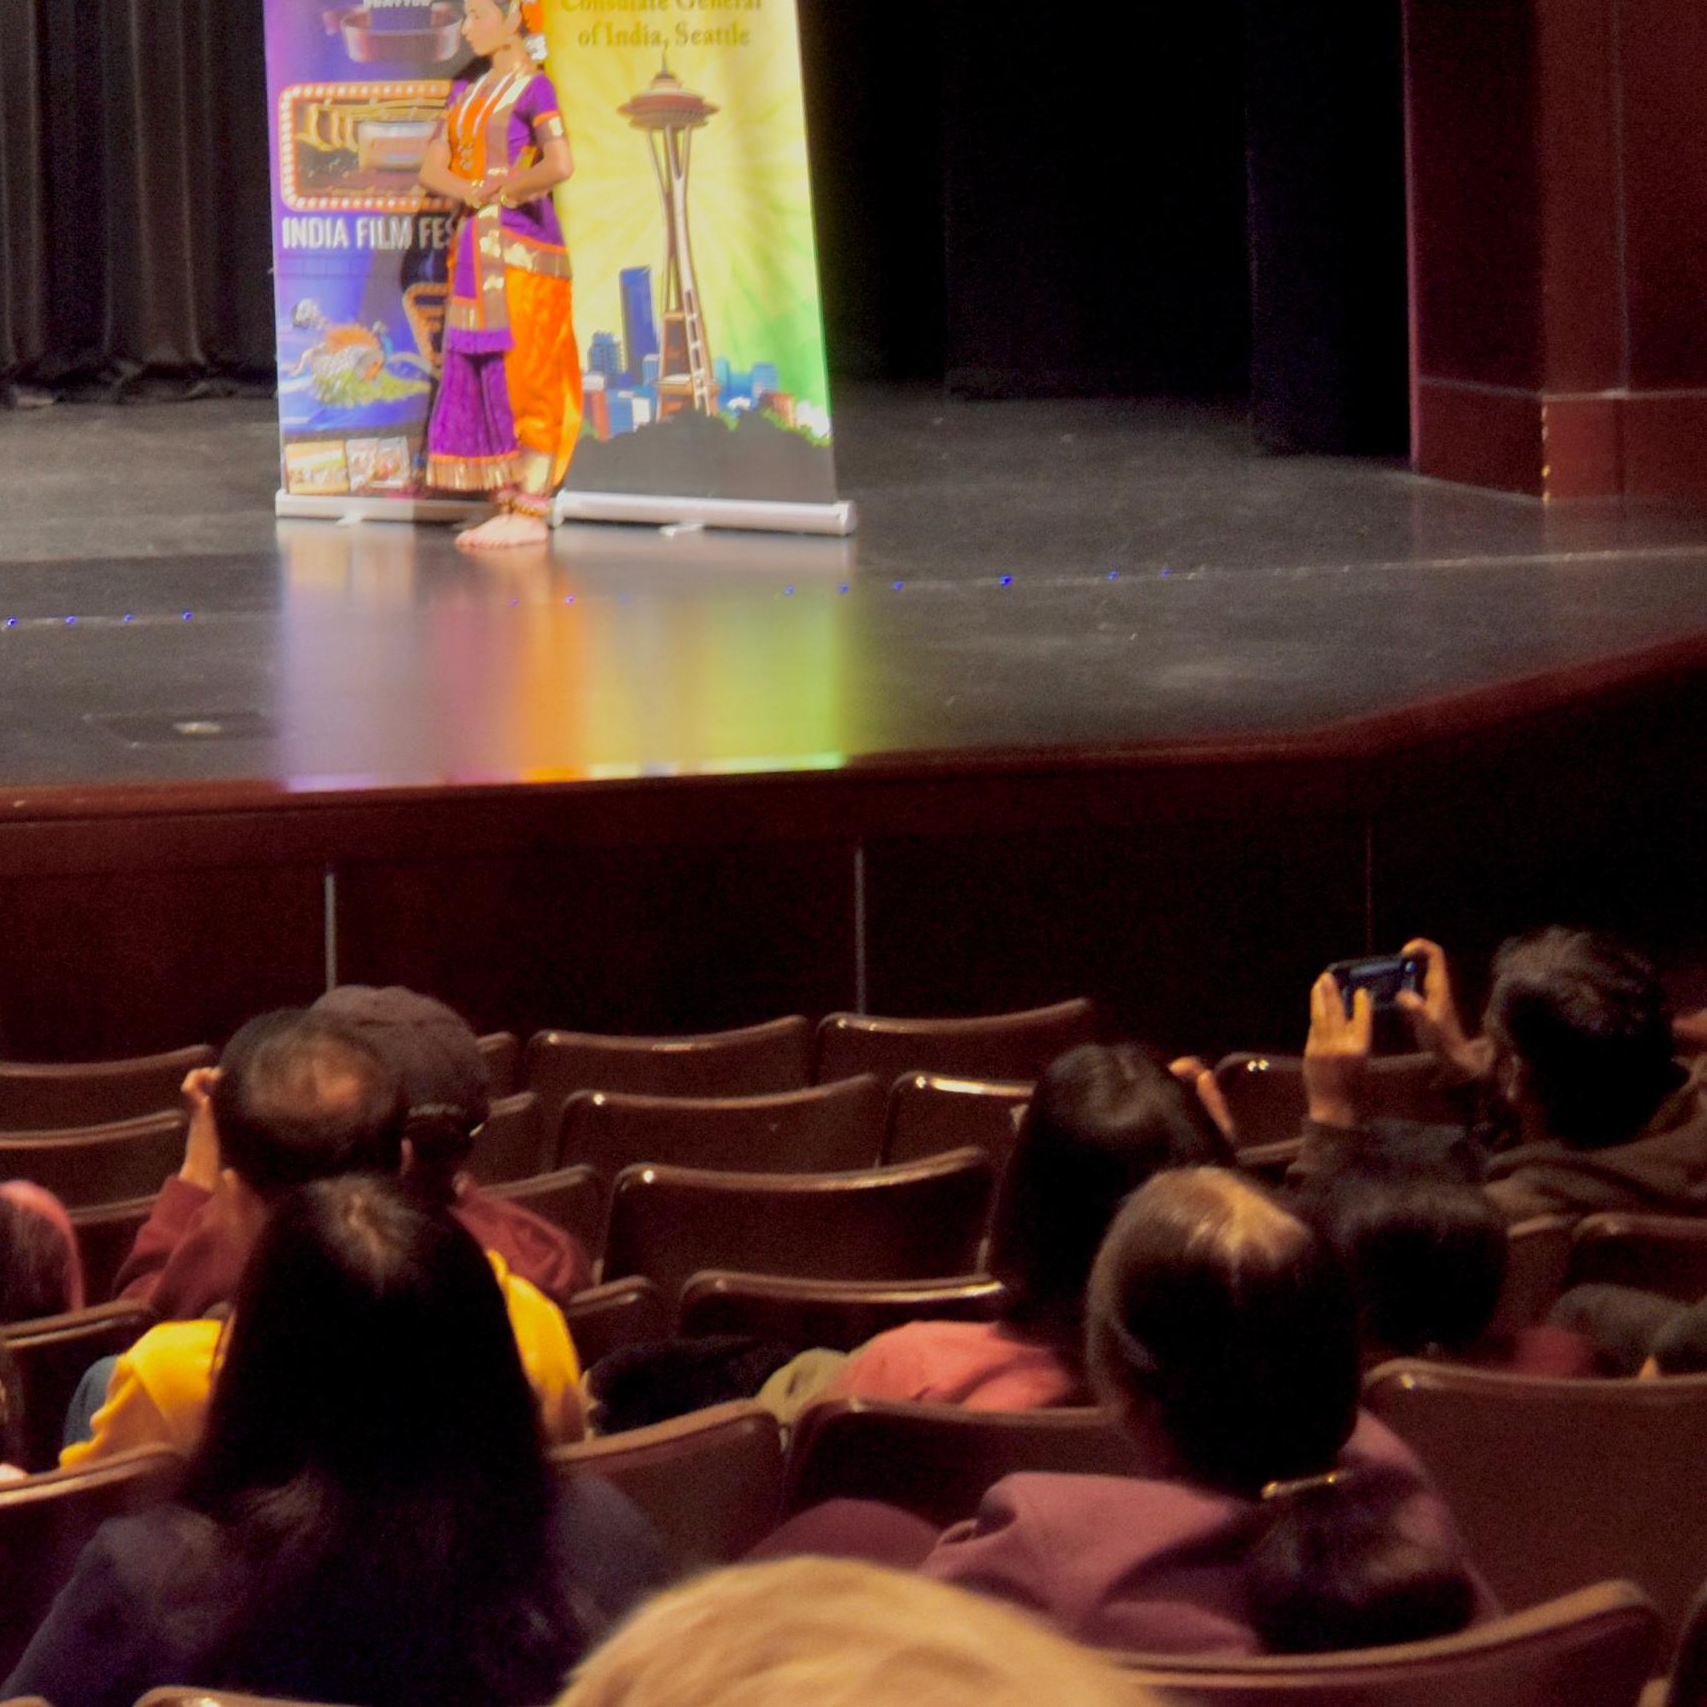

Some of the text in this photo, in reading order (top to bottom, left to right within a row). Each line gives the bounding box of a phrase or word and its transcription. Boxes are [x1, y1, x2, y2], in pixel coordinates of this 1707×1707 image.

[578, 20, 750, 50] of India, Seattle
[282, 216, 350, 250] INDIA
[355, 215, 414, 250] FILM
